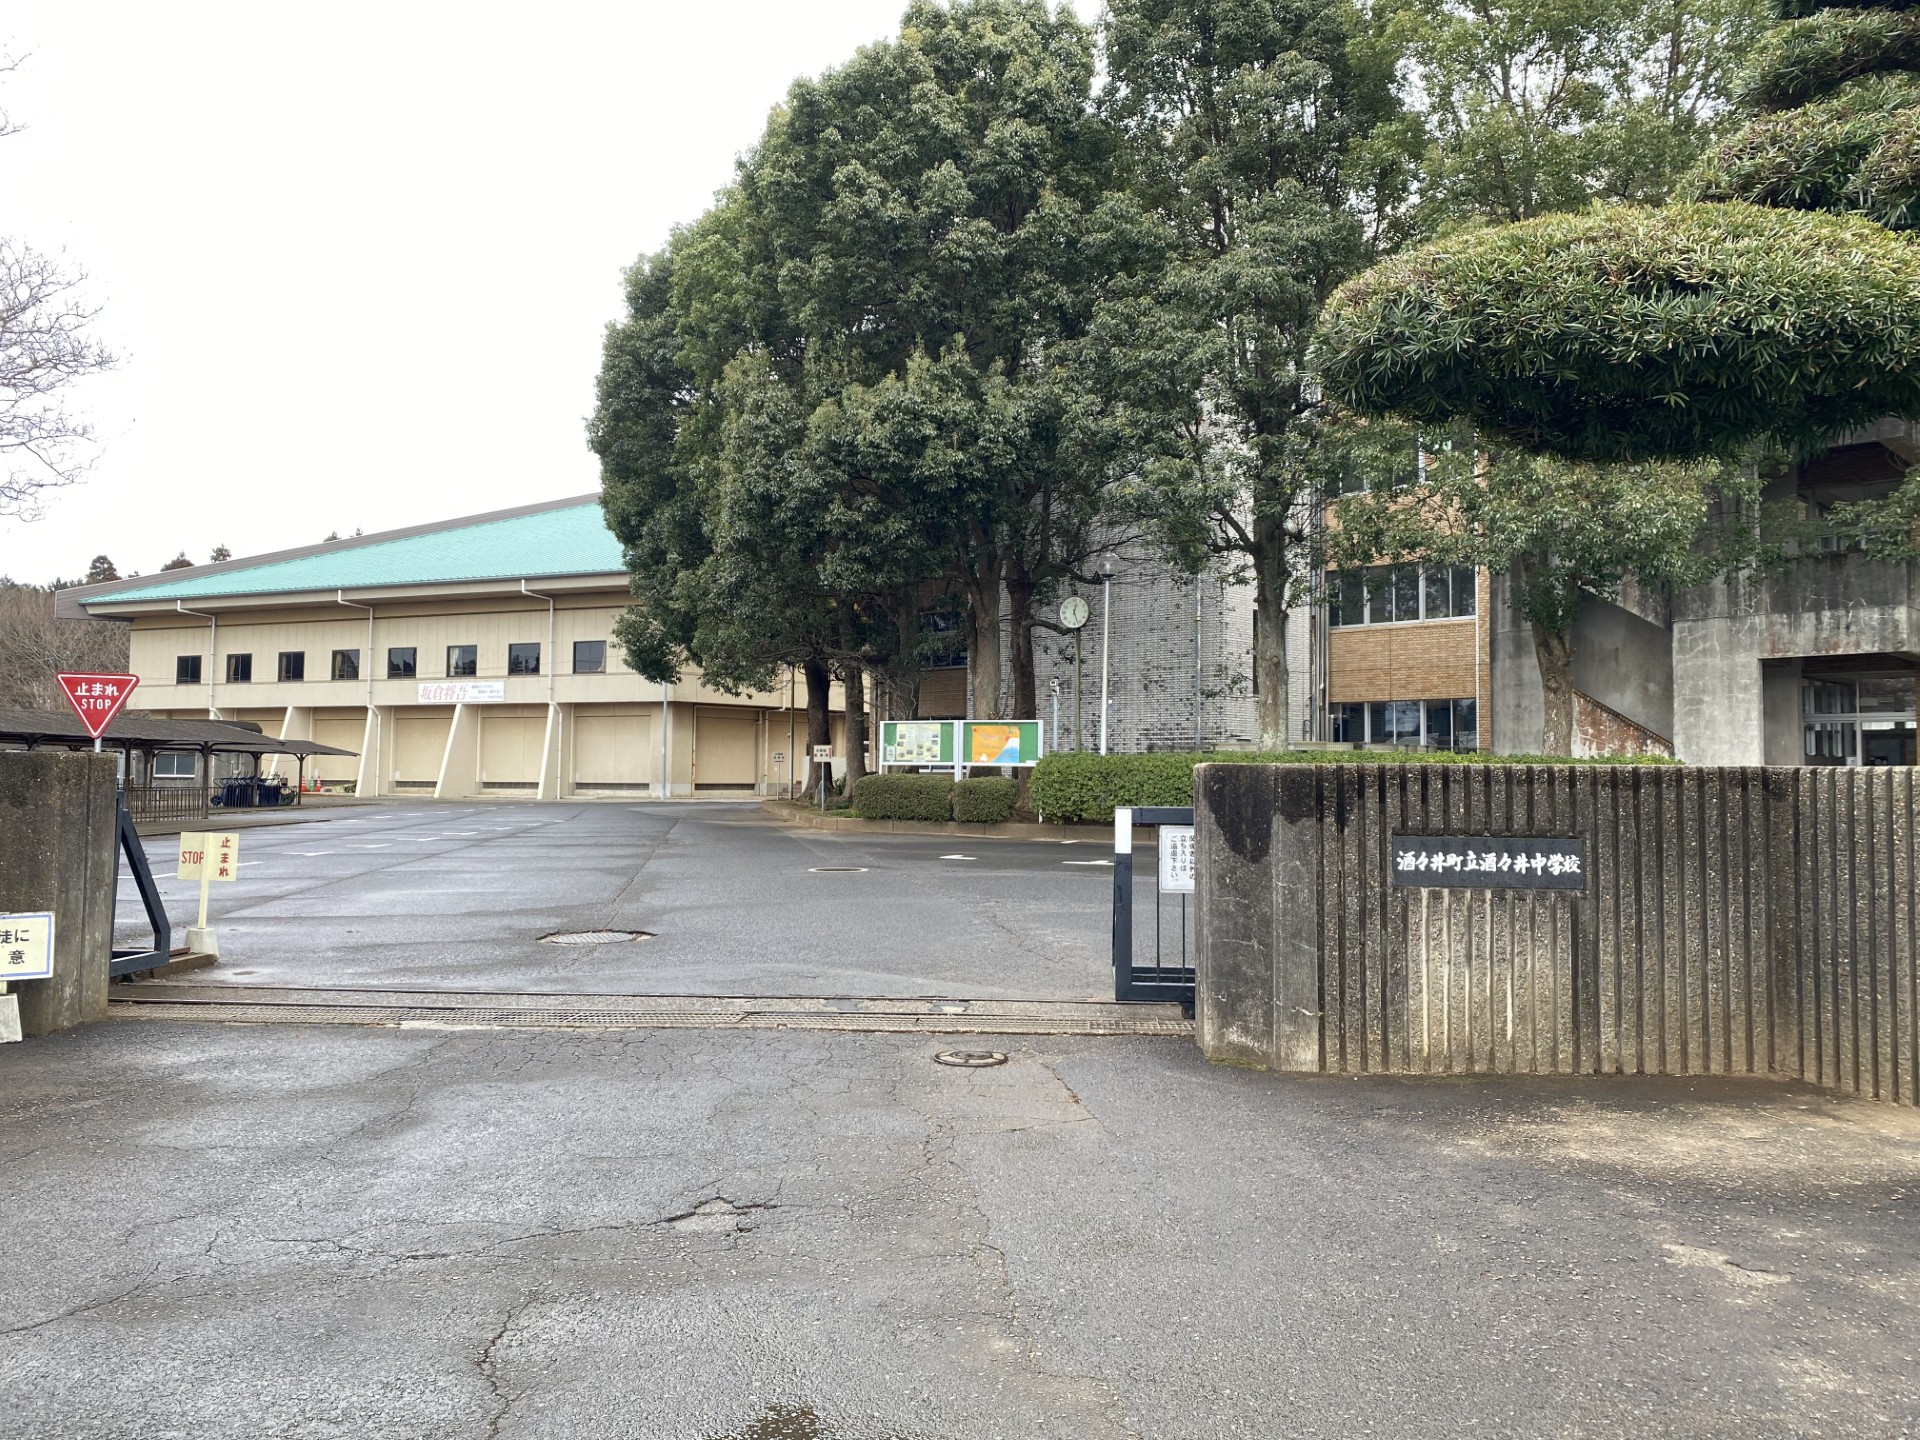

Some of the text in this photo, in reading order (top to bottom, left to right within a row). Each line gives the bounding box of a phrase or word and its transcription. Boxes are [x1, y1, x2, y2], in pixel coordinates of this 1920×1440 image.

[74, 682, 119, 696] 止まれ
[81, 699, 111, 709] STOP
[181, 850, 204, 864] STOP
[219, 837, 231, 877] 止まれ
[1397, 851, 1581, 876] 酒々井町立酒々井中学校
